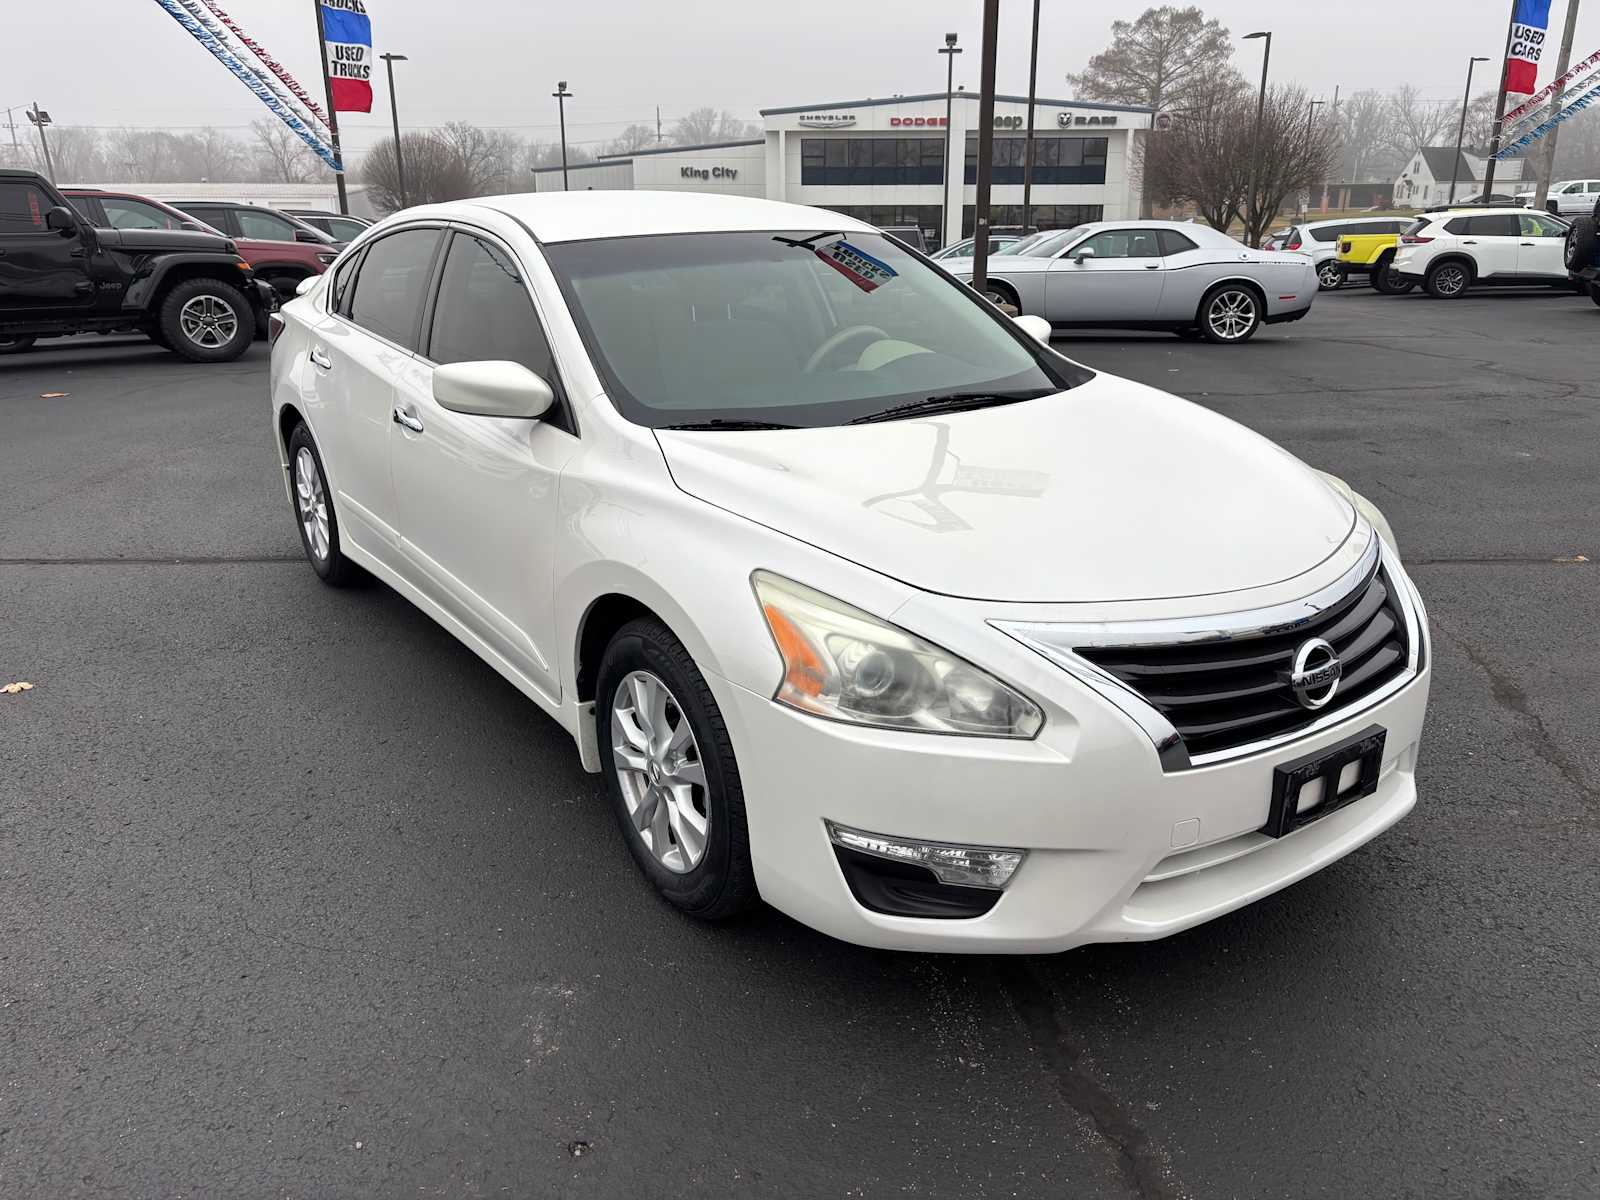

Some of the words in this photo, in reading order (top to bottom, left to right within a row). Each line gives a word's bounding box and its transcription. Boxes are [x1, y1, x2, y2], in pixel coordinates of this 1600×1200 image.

[324, 0, 366, 13] RUCKS
[1514, 25, 1545, 45] USED
[335, 45, 364, 62] USED
[1511, 42, 1542, 61] CARS
[331, 60, 370, 79] TRUCKS
[890, 117, 949, 127] DODGE
[994, 115, 1023, 130] eep
[1075, 116, 1117, 126] RAM
[680, 167, 709, 180] King
[712, 166, 737, 180] City
